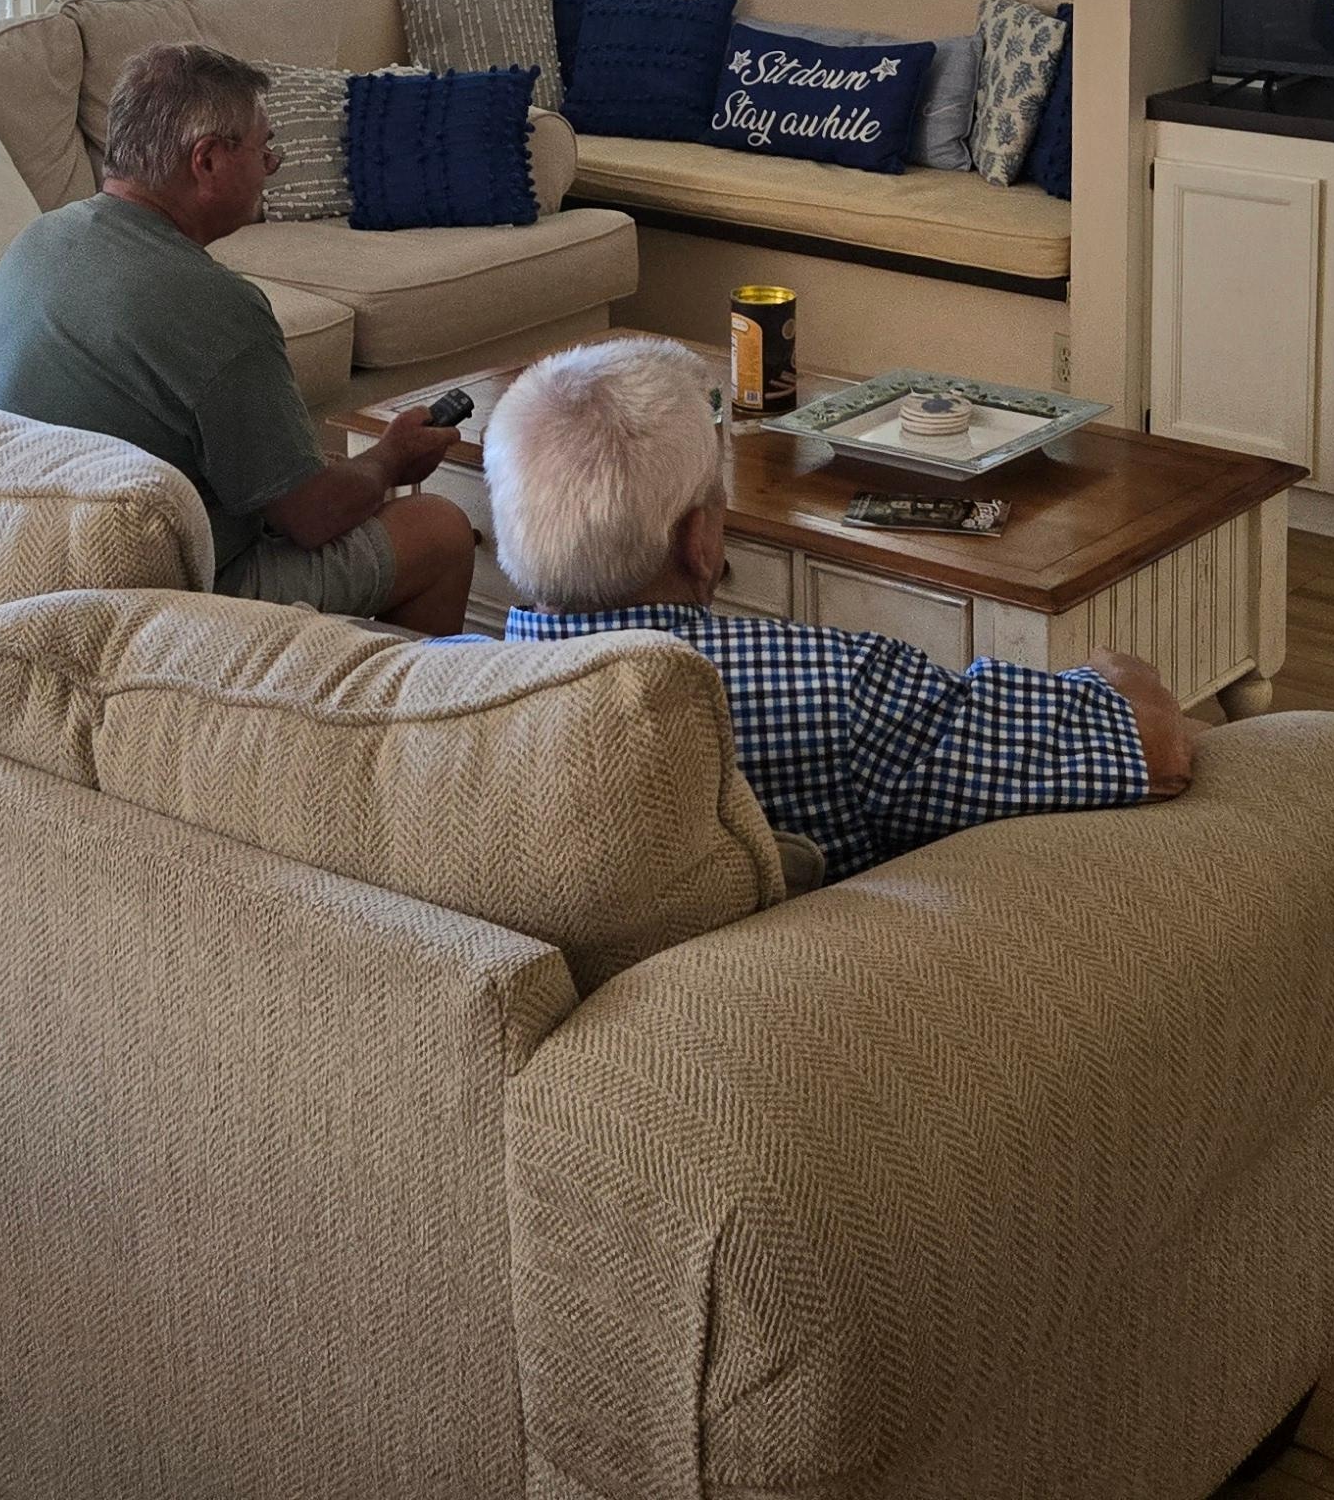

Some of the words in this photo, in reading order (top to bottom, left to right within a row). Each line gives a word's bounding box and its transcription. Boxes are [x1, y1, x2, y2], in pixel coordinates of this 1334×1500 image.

[741, 50, 800, 86] Sit
[788, 59, 870, 91] down
[712, 90, 777, 147] Stay
[780, 105, 882, 143] awhile
